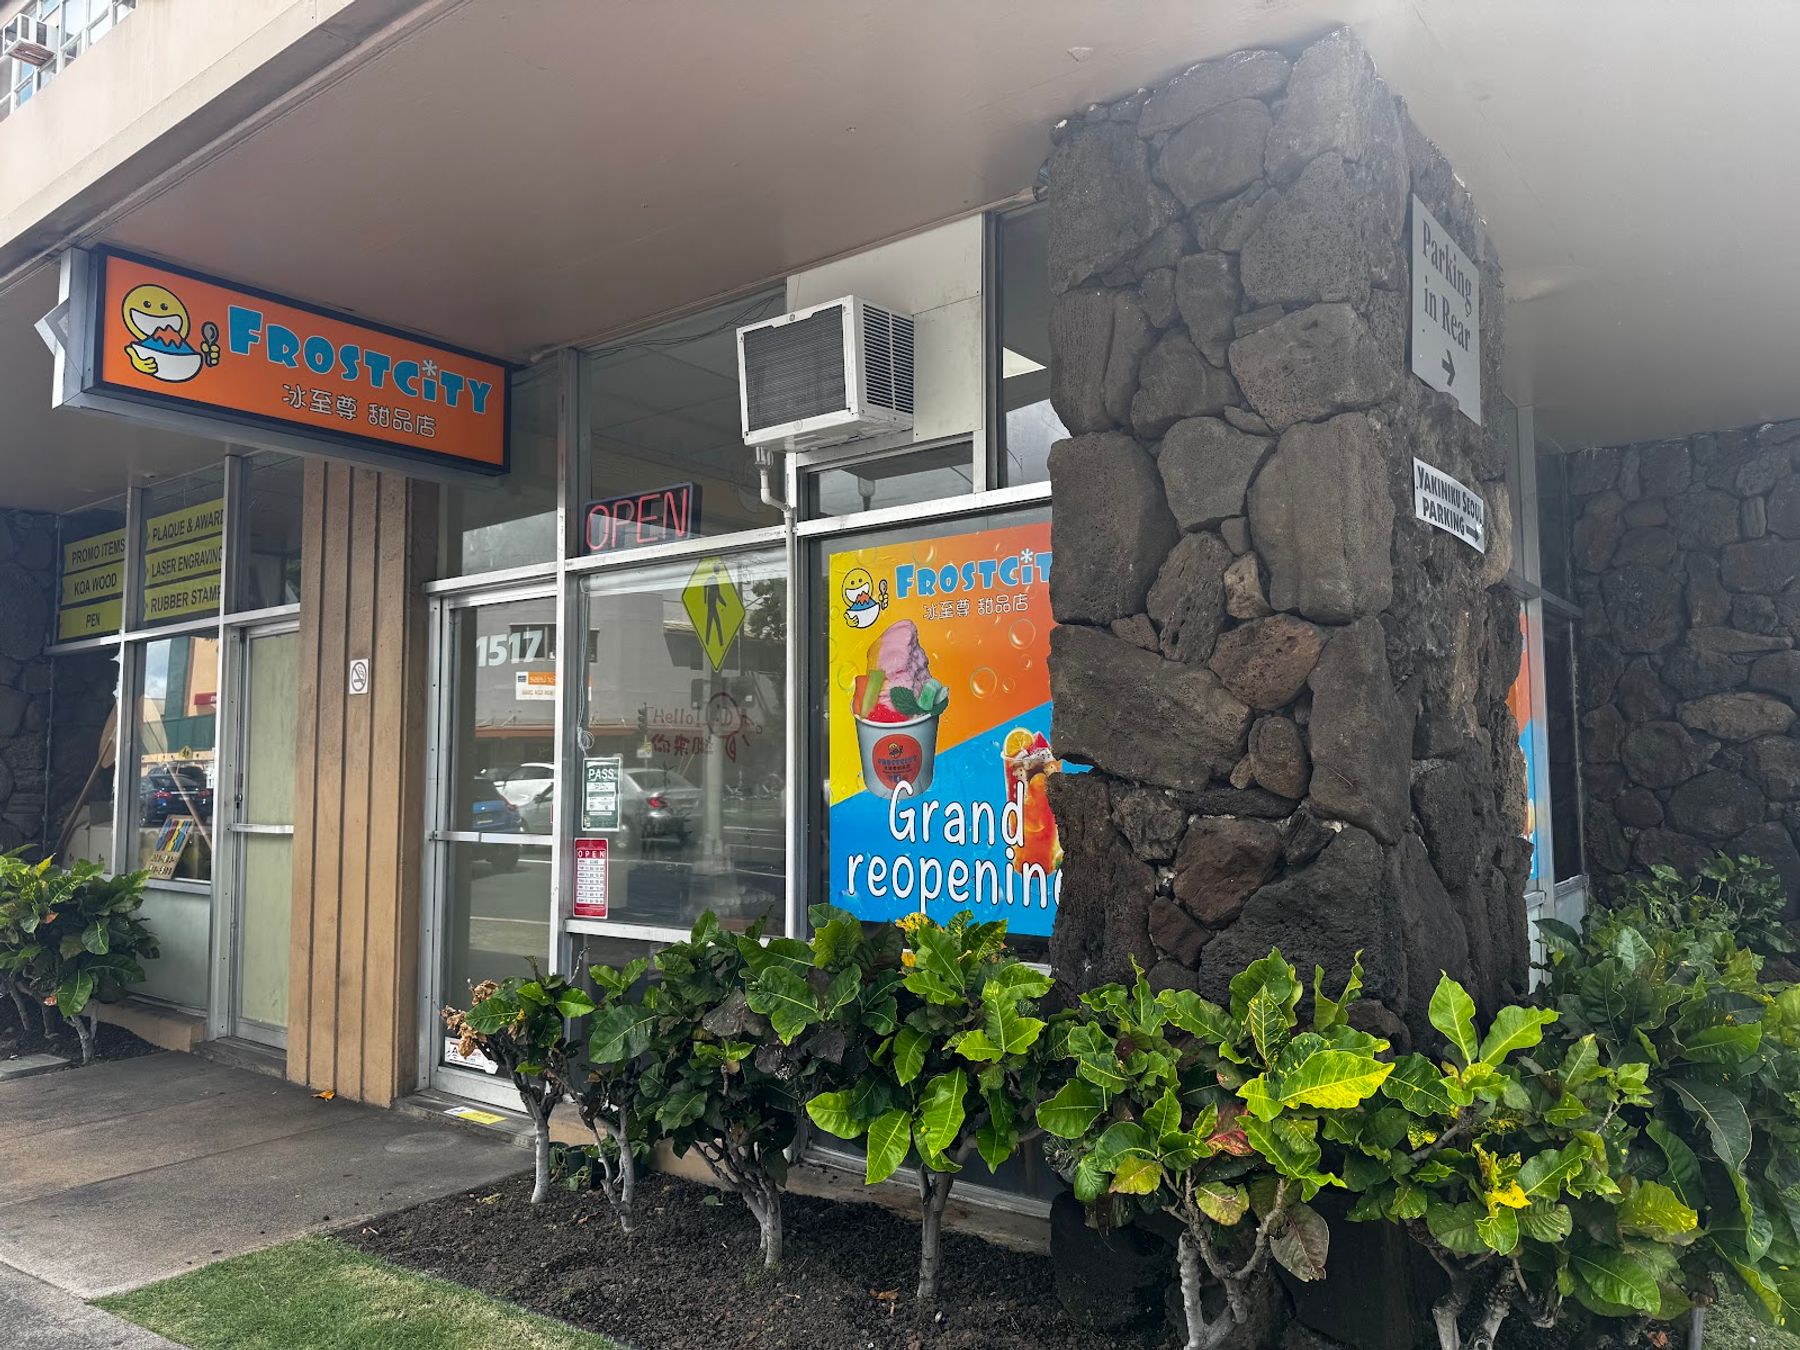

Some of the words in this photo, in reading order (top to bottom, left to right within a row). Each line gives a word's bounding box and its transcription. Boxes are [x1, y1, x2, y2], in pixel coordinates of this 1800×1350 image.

[1423, 219, 1472, 317] Parking
[1424, 275, 1438, 323] in
[1441, 295, 1471, 351] Rear
[282, 383, 358, 420] 冰至尊
[367, 403, 437, 438] 甜品店
[1416, 465, 1461, 509] YAKINIKU
[152, 519, 185, 542] PLAQUE
[186, 518, 193, 533] &
[586, 488, 688, 550] OPEN
[1422, 496, 1465, 536] PARKING
[72, 544, 100, 565] PROMO
[101, 538, 126, 557] ITEMS
[151, 558, 177, 578] LASER
[74, 579, 91, 596] KOA
[92, 572, 117, 591] WOOD
[895, 547, 1053, 600] FROSTCiT
[151, 591, 189, 613] RUBBER
[923, 598, 969, 620] 冰至尊
[977, 592, 1029, 615] 甜品店
[86, 613, 101, 629] PEN
[476, 629, 543, 668] 1517
[588, 768, 616, 780] PASS
[888, 779, 1025, 848] Grand
[578, 850, 605, 858] OPEN
